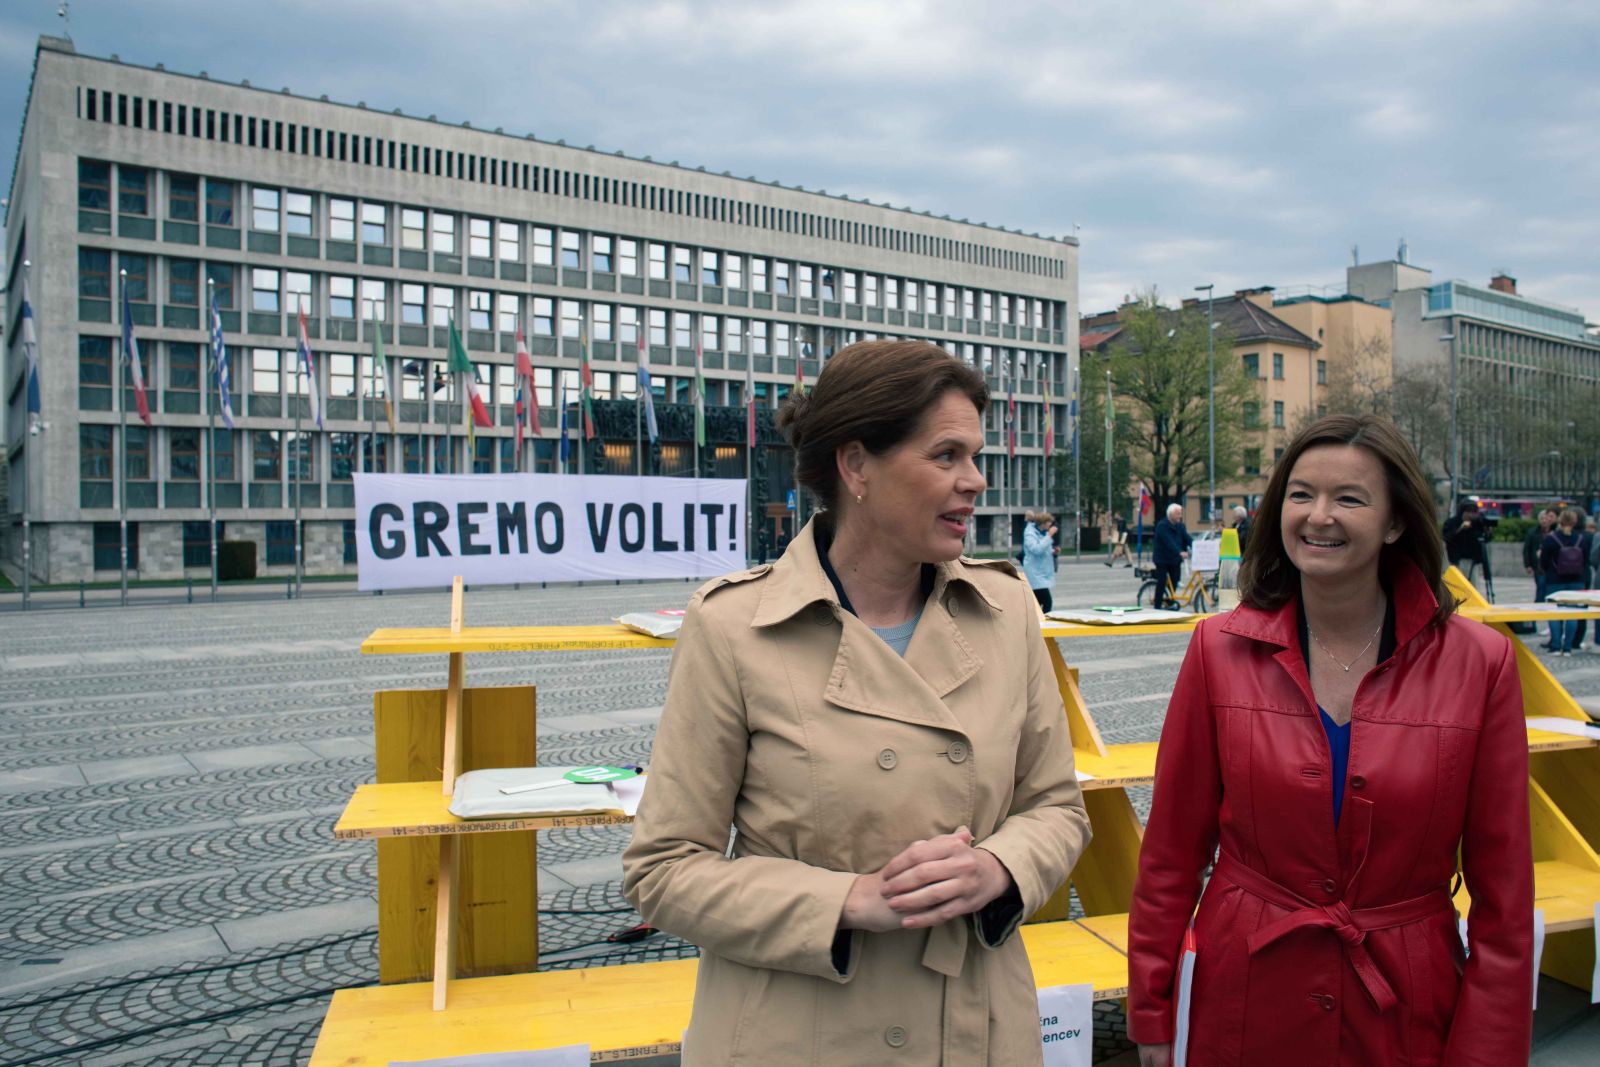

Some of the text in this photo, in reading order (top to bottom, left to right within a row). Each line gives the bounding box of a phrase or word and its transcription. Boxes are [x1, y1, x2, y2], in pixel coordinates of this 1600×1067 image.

[369, 500, 738, 560] GREMO VOLIT!
[1040, 1029, 1081, 1043] encev
